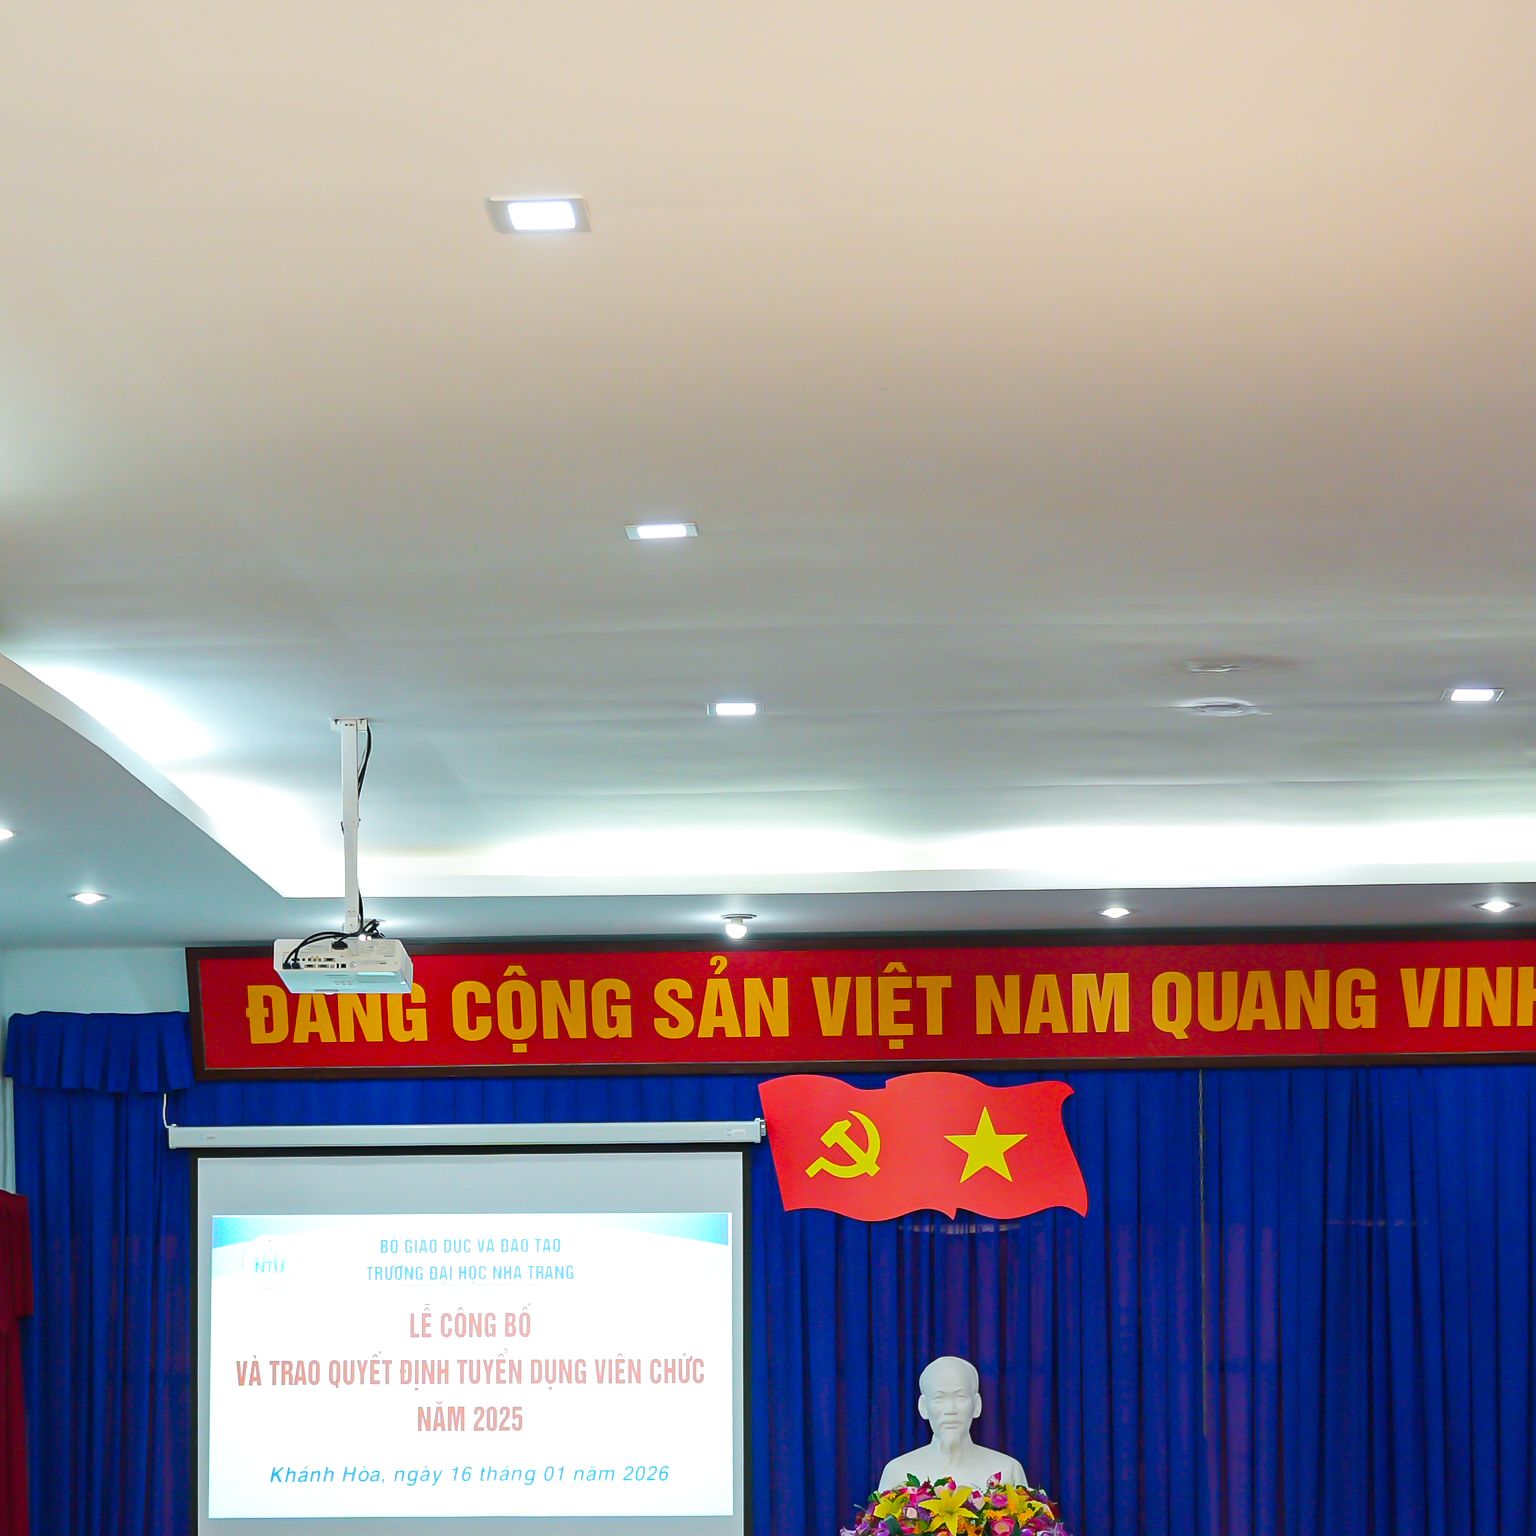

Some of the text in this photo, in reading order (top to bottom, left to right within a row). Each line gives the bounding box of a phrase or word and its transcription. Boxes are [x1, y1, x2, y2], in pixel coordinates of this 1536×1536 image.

[451, 965, 632, 1052] CỘNG
[653, 955, 790, 1039] SẢN
[811, 961, 952, 1049] VIỆT
[975, 972, 1131, 1035] NAM
[1151, 968, 1377, 1040] QUANG
[255, 1261, 285, 1273] NTU
[428, 1265, 453, 1284] ĐẠI
[458, 1265, 487, 1284] HỌC
[492, 1265, 522, 1280] NHA
[527, 1264, 575, 1280] TRANG
[409, 1302, 532, 1338] LỄ CÔNG BỐ
[235, 1347, 705, 1391] VÀ TRAO QUYẾT ĐỊNH TUYỂN DỤNG VIÊN CHỨC
[417, 1400, 524, 1432] NĂM 2025
[269, 1464, 671, 1487] Khánh Hòa, ngày 16 tháng 01 năm 2026
